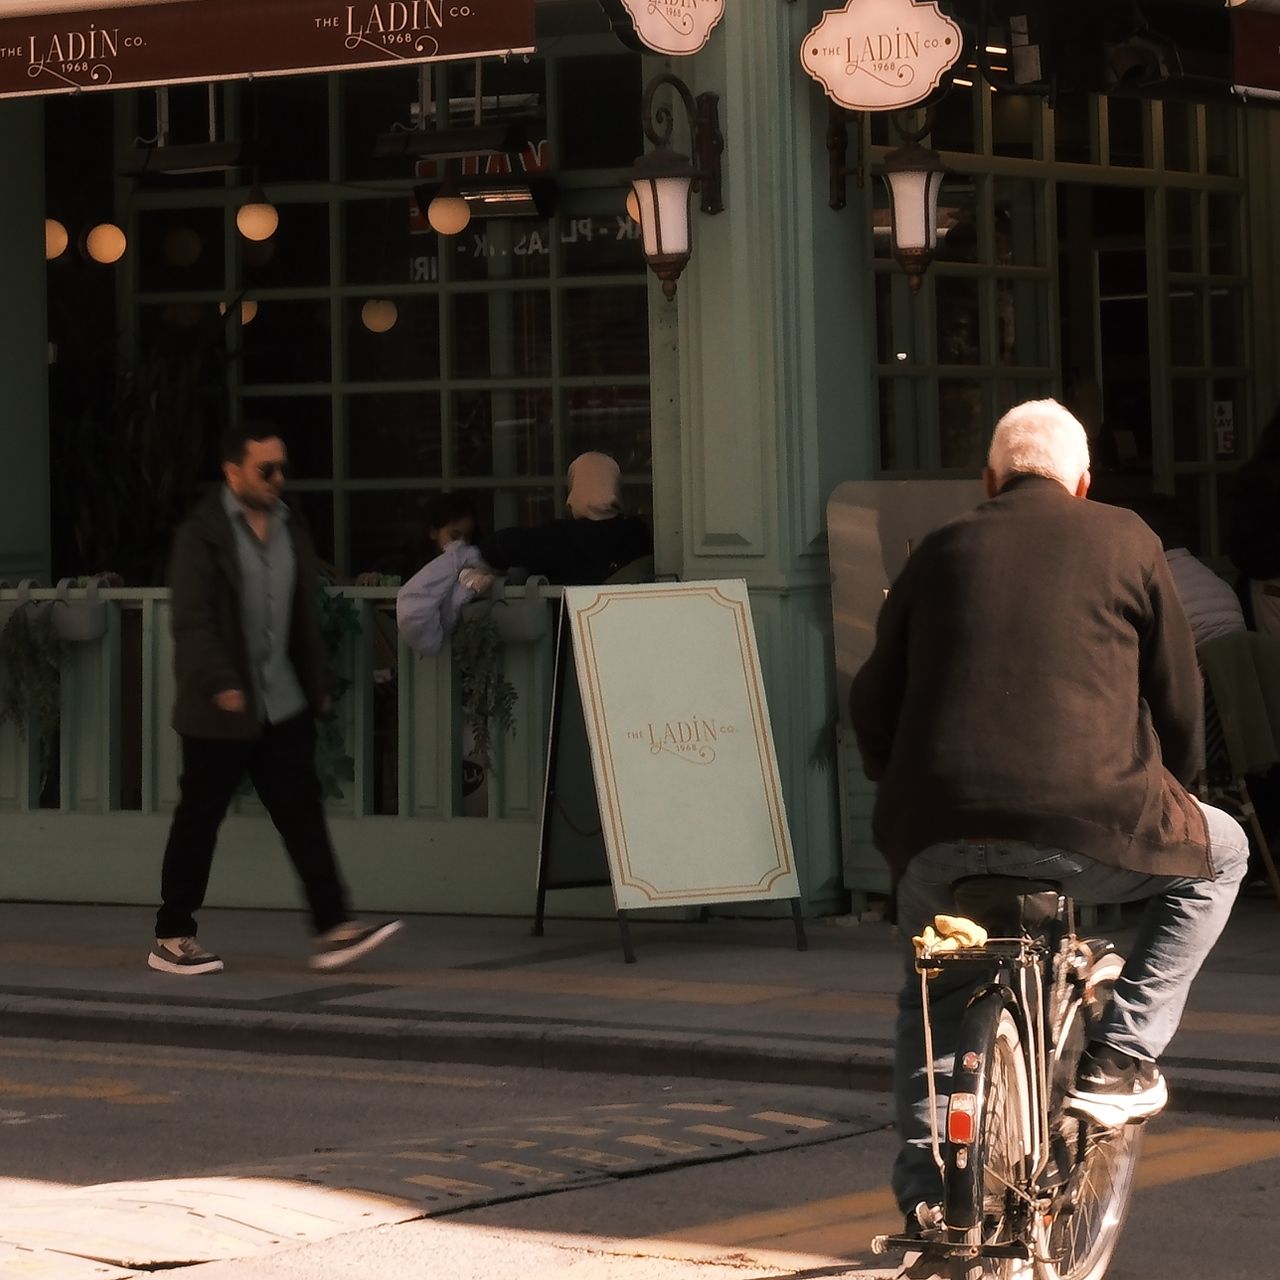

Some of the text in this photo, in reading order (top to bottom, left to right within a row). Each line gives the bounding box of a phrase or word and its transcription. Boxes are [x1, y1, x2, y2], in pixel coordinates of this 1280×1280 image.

[315, 17, 339, 28] THE
[450, 6, 475, 17] CO.
[0, 23, 147, 65] THE LADİN CO.
[382, 33, 412, 45] 1968
[822, 26, 942, 63] THE LADİN CO.
[61, 62, 89, 73] 1968
[873, 62, 896, 72] 1968
[1215, 418, 1232, 428] AY
[648, 714, 717, 745] LADİN
